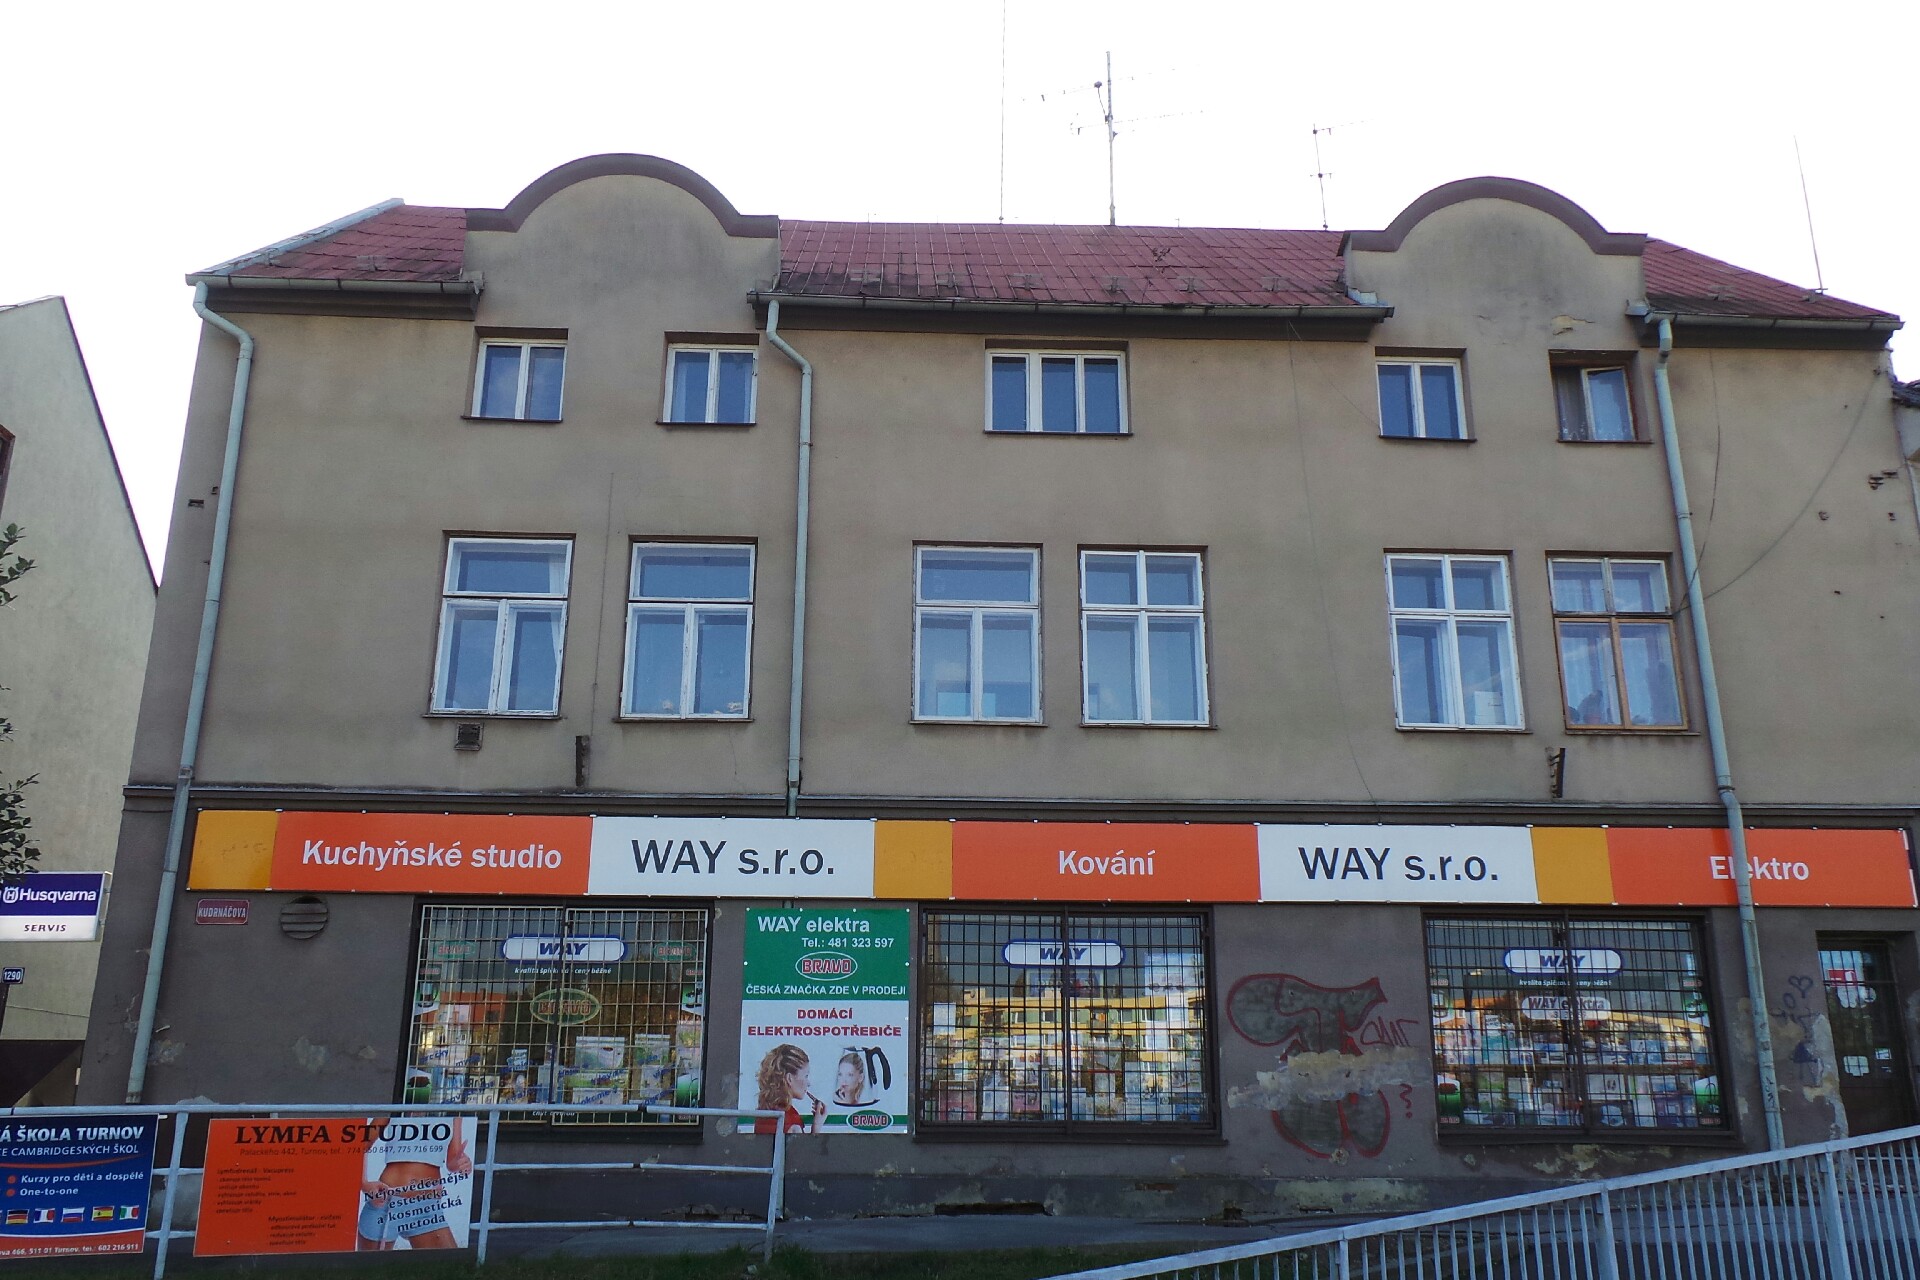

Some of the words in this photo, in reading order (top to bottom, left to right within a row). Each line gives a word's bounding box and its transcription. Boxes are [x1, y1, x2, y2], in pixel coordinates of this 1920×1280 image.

[302, 838, 462, 871] Kuchyňské
[471, 840, 562, 870] studio
[632, 839, 727, 875] WAY
[738, 844, 835, 876] s.r.o.
[1058, 850, 1157, 877] Kování
[1298, 847, 1391, 882] WAY
[1404, 851, 1499, 882] s.r.o.
[20, 888, 97, 904] Husqvarna
[198, 905, 247, 919] KUDRNÁČOVA
[24, 923, 67, 933] SERVIS
[757, 916, 801, 933] WAY
[806, 916, 870, 933] elektra
[540, 943, 588, 955] WAY
[828, 937, 848, 949] 481
[852, 938, 871, 949] 323
[874, 938, 894, 950] 597
[1040, 947, 1088, 960] WAY
[802, 958, 851, 974] BRAVO
[4, 970, 21, 981] 1290
[746, 983, 782, 996] ČESKÁ
[783, 984, 827, 996] ZNAČKA
[829, 985, 849, 996] ZDE
[852, 986, 859, 996] V
[862, 985, 906, 996] PRODEJI
[1562, 997, 1604, 1010] ektra
[797, 1007, 853, 1019] DOMÁCÍ
[748, 1023, 902, 1037] ELEKTROSPOTŘEBIČE
[852, 1115, 888, 1126] BRAVO
[0, 1125, 11, 1143] Á
[17, 1124, 71, 1143] ŠKOLA
[77, 1126, 145, 1141] TURNOV
[235, 1125, 331, 1144] LYMFA
[341, 1123, 451, 1144] STUDIO
[0, 1147, 8, 1157] E
[11, 1144, 111, 1156] CAMBRIDGESKÝCH
[113, 1143, 139, 1155] ŠKOL
[21, 1175, 51, 1186] Kurzy
[52, 1175, 70, 1185] pro
[20, 1187, 79, 1197] One-to-one
[389, 1186, 448, 1209] estetická
[377, 1216, 384, 1225] a
[389, 1195, 463, 1222] kosmetická
[397, 1213, 446, 1233] metoda
